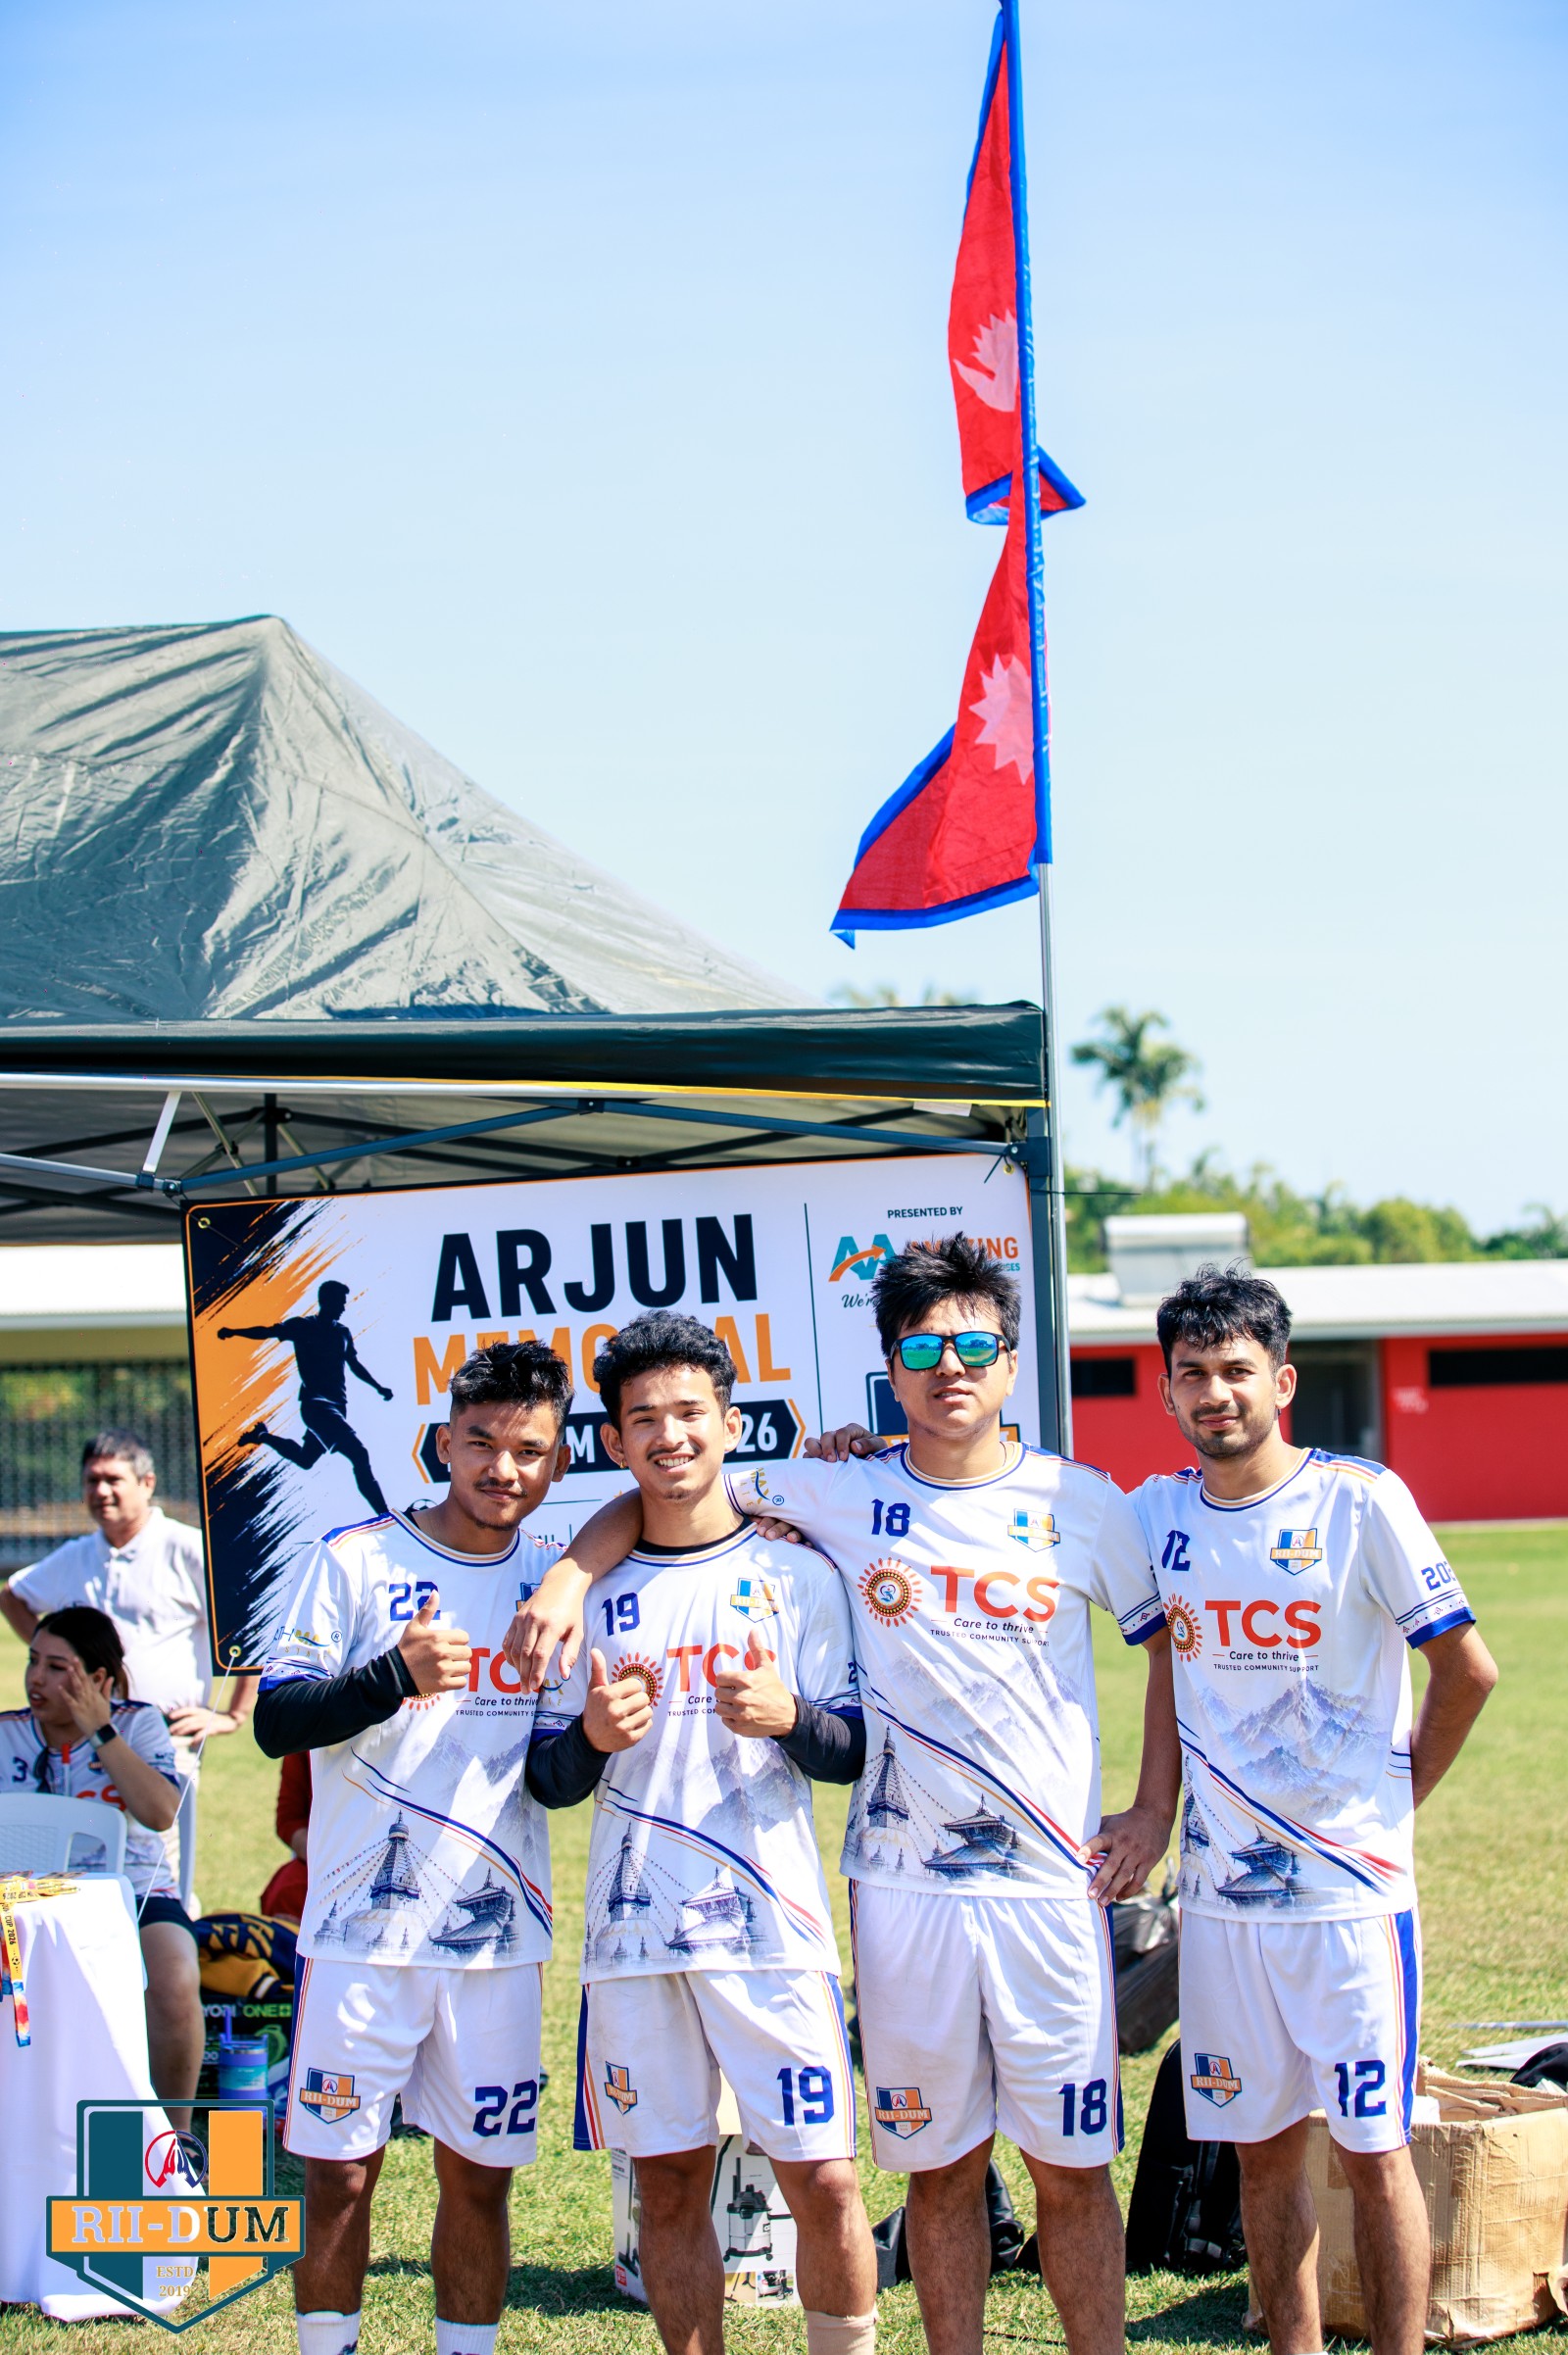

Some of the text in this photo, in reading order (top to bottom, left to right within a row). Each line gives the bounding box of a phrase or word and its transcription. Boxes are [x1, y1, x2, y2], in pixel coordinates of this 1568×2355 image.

[887, 1206, 963, 1218] PRESENTED BY
[431, 1213, 758, 1323] ARJUN
[841, 1293, 880, 1308] We'r
[871, 1498, 911, 1538] 18
[389, 1581, 441, 1622] 22
[931, 1565, 1060, 1622] TCS
[602, 1592, 641, 1636] 19
[954, 1617, 1035, 1634] Care to thrive
[1204, 1599, 1322, 1648] TCS
[969, 1633, 1019, 1644] COMMUNITY
[1229, 1651, 1299, 1662] Care to thrive
[474, 1696, 498, 1706] Care
[501, 1696, 513, 1706] to
[514, 1696, 539, 1707] thriv
[688, 1694, 710, 1705] Care
[668, 1708, 699, 1717] TRUSTED
[4, 1915, 14, 1928] CUP
[7, 1929, 17, 1945] 2026
[1196, 2077, 1239, 2089] RII-DUM
[1334, 2059, 1387, 2118] 12
[304, 2090, 357, 2107] RII-DUM
[776, 2065, 834, 2126] 19
[472, 2079, 537, 2137] 22
[878, 2109, 929, 2120] RII-DUM
[1058, 2078, 1106, 2136] 18
